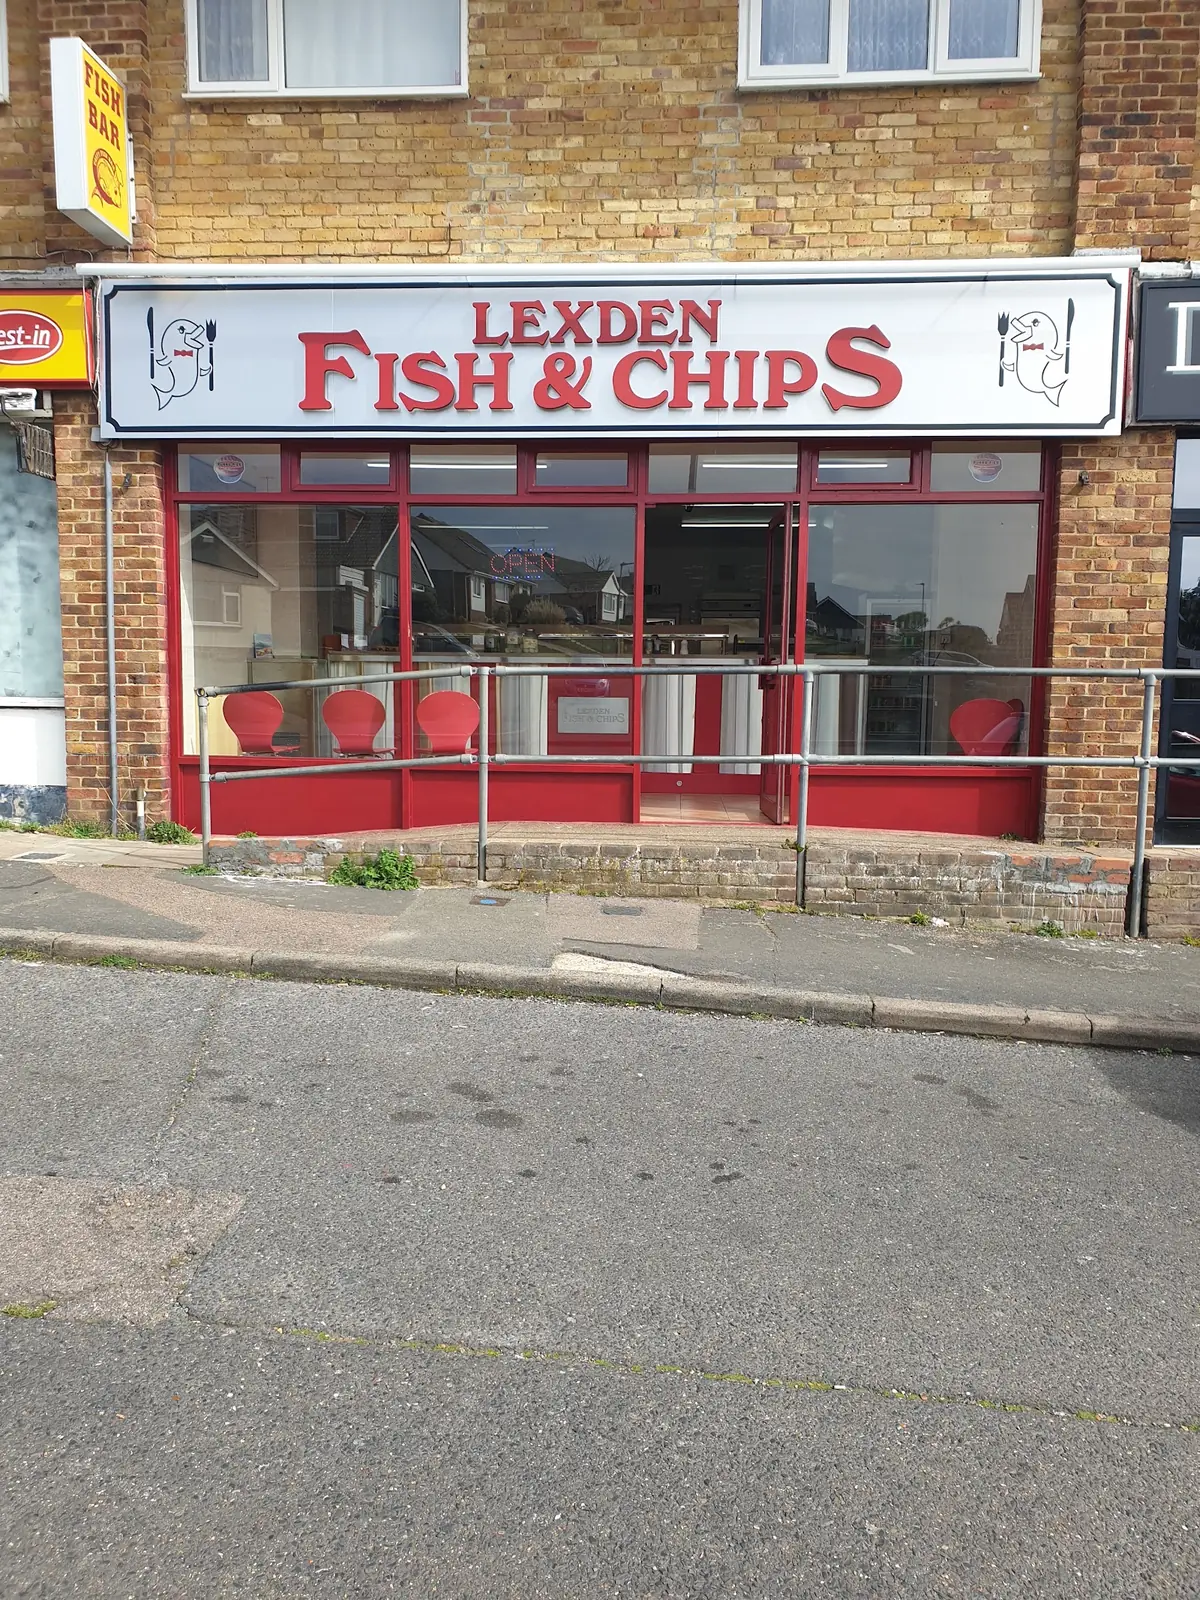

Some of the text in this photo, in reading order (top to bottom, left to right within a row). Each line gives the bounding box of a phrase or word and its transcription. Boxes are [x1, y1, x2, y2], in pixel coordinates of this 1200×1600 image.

[84, 60, 121, 117] FISH
[88, 98, 121, 151] BAR
[472, 299, 723, 346] LEXDEN
[298, 324, 903, 412] FISH & CHIPS
[490, 553, 555, 573] OPEN
[564, 712, 584, 723] ISH
[596, 712, 625, 723] CHIPS
